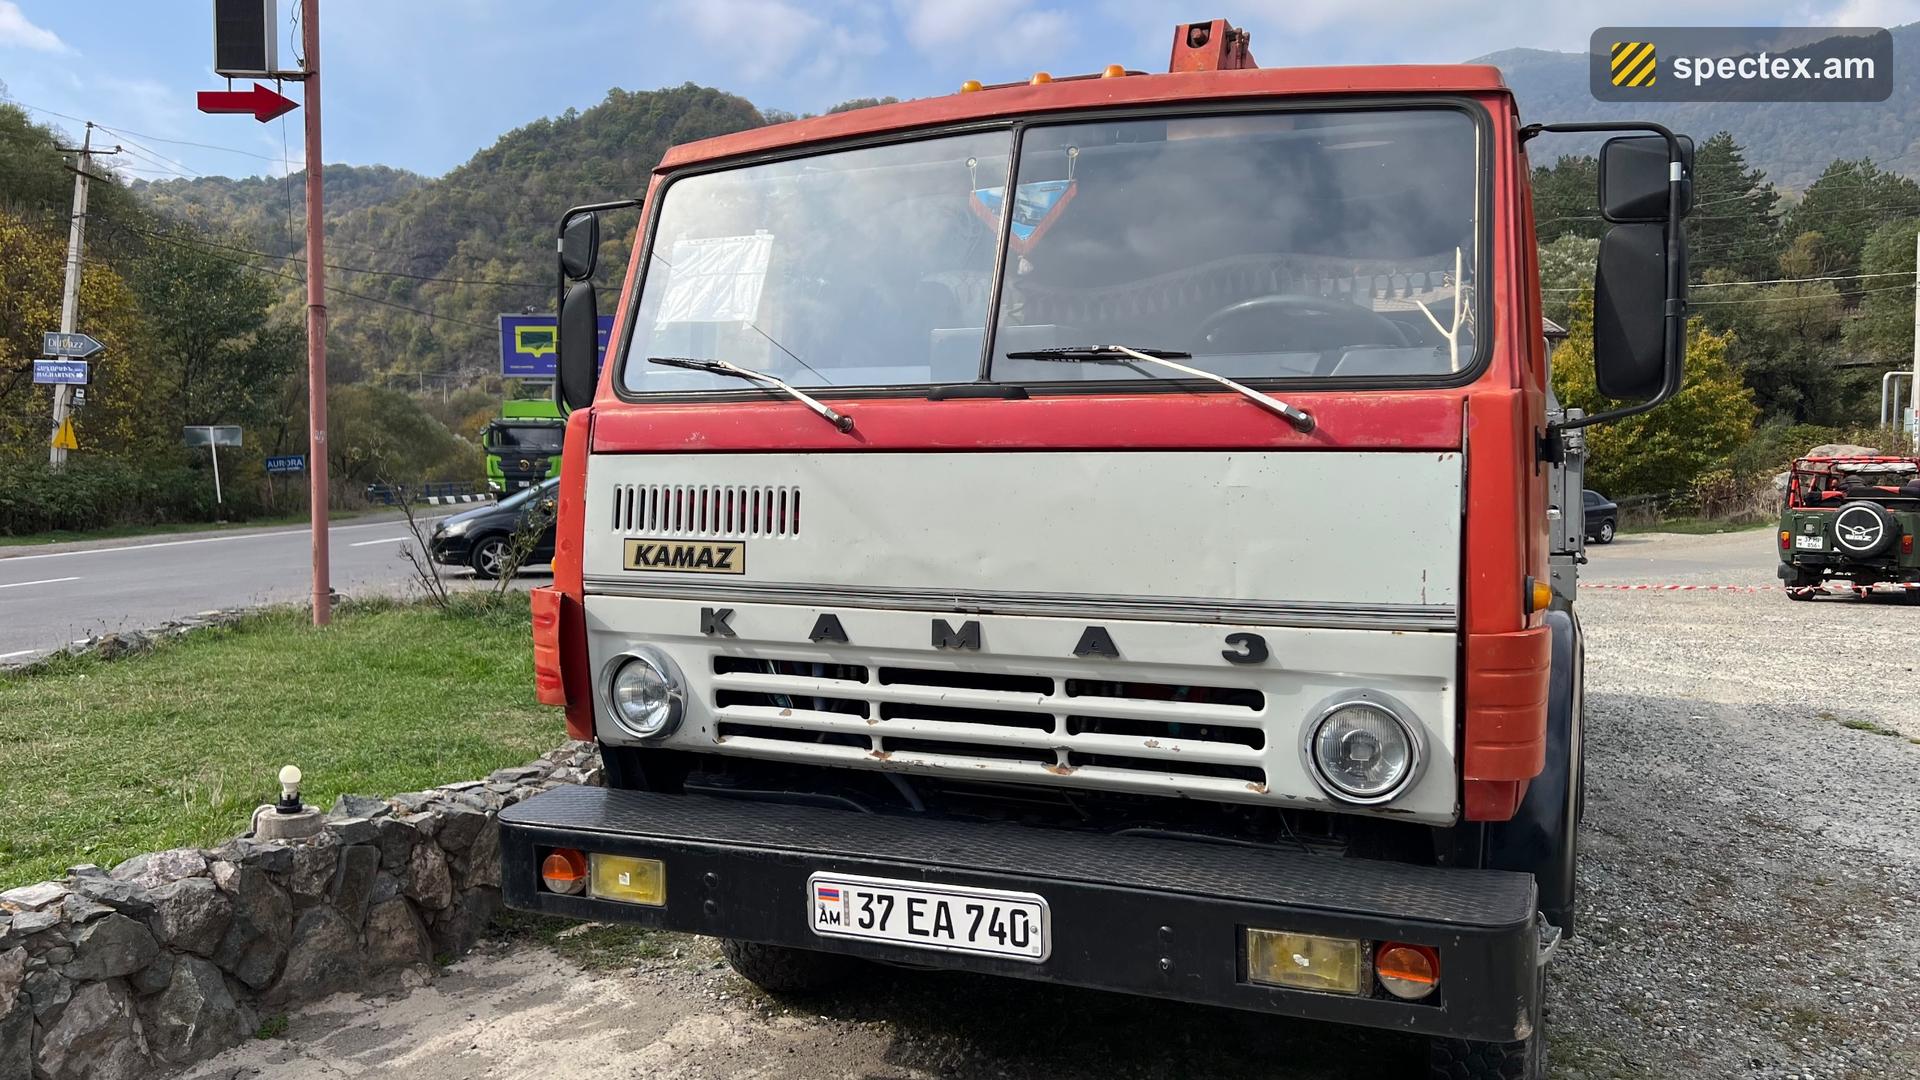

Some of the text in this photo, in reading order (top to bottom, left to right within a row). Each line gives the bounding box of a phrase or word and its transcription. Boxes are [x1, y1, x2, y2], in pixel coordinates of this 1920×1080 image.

[267, 458, 303, 468] AURORA
[633, 543, 737, 570] KAMAZ
[818, 907, 841, 926] AM
[856, 892, 1029, 948] 37 EA 740
